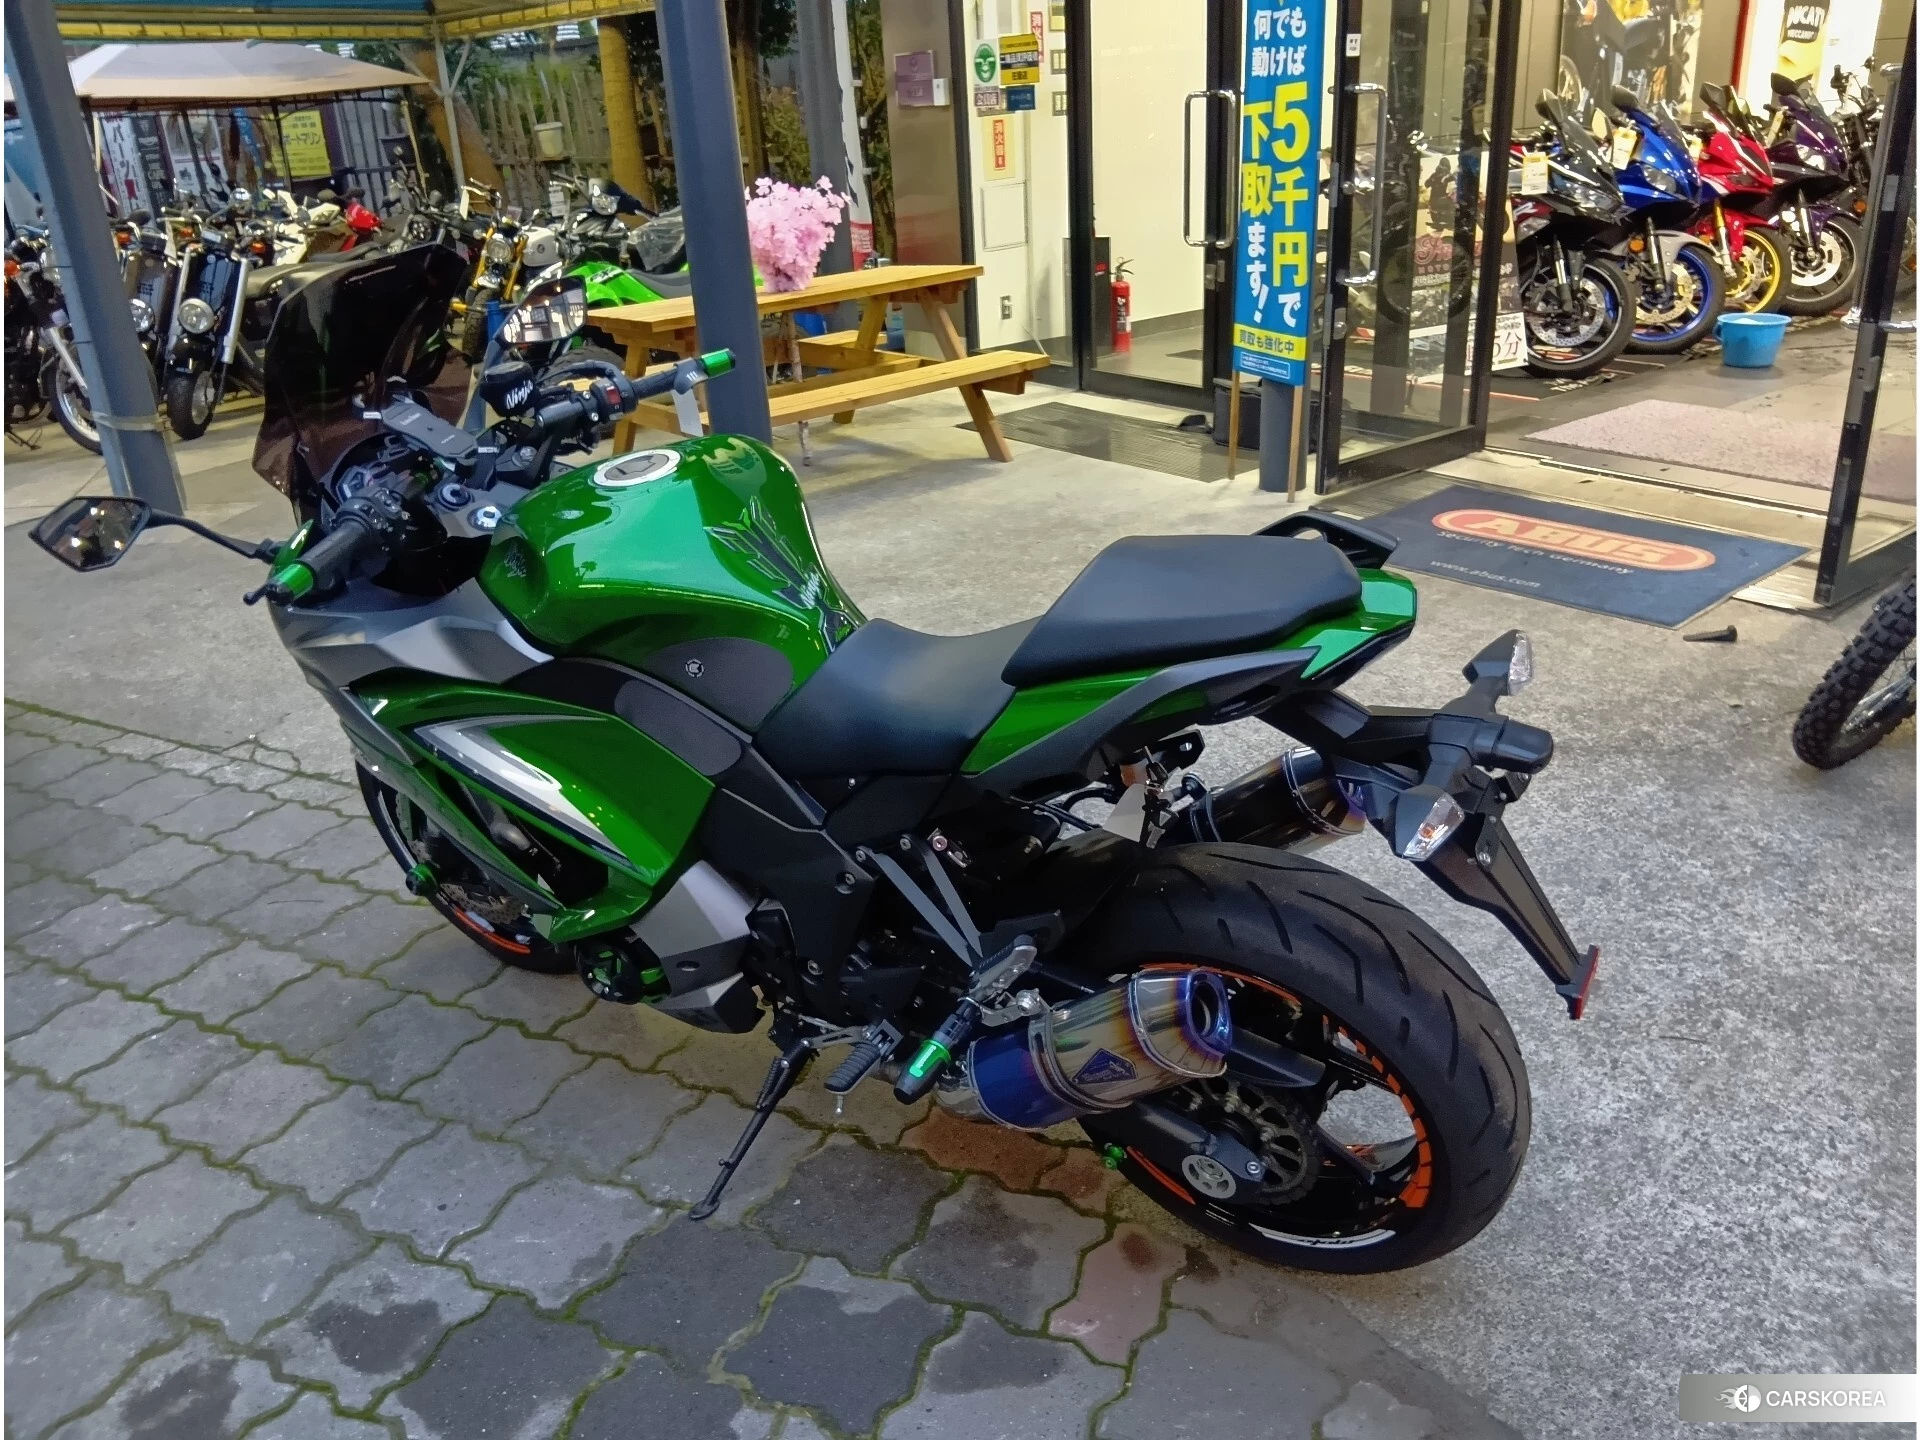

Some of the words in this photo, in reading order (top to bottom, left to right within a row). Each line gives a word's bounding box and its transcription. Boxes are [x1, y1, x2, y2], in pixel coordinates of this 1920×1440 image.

[1254, 6, 1307, 41] 何でも
[1251, 44, 1307, 78] 動けば
[1271, 81, 1310, 328] 5千円で
[1239, 329, 1294, 354] 買取も強化中
[505, 379, 534, 410] Ninja
[1436, 531, 1505, 548] Security
[1549, 553, 1635, 575] Germany
[1467, 516, 1673, 564] ABUS
[1430, 560, 1541, 588] www.abus.com
